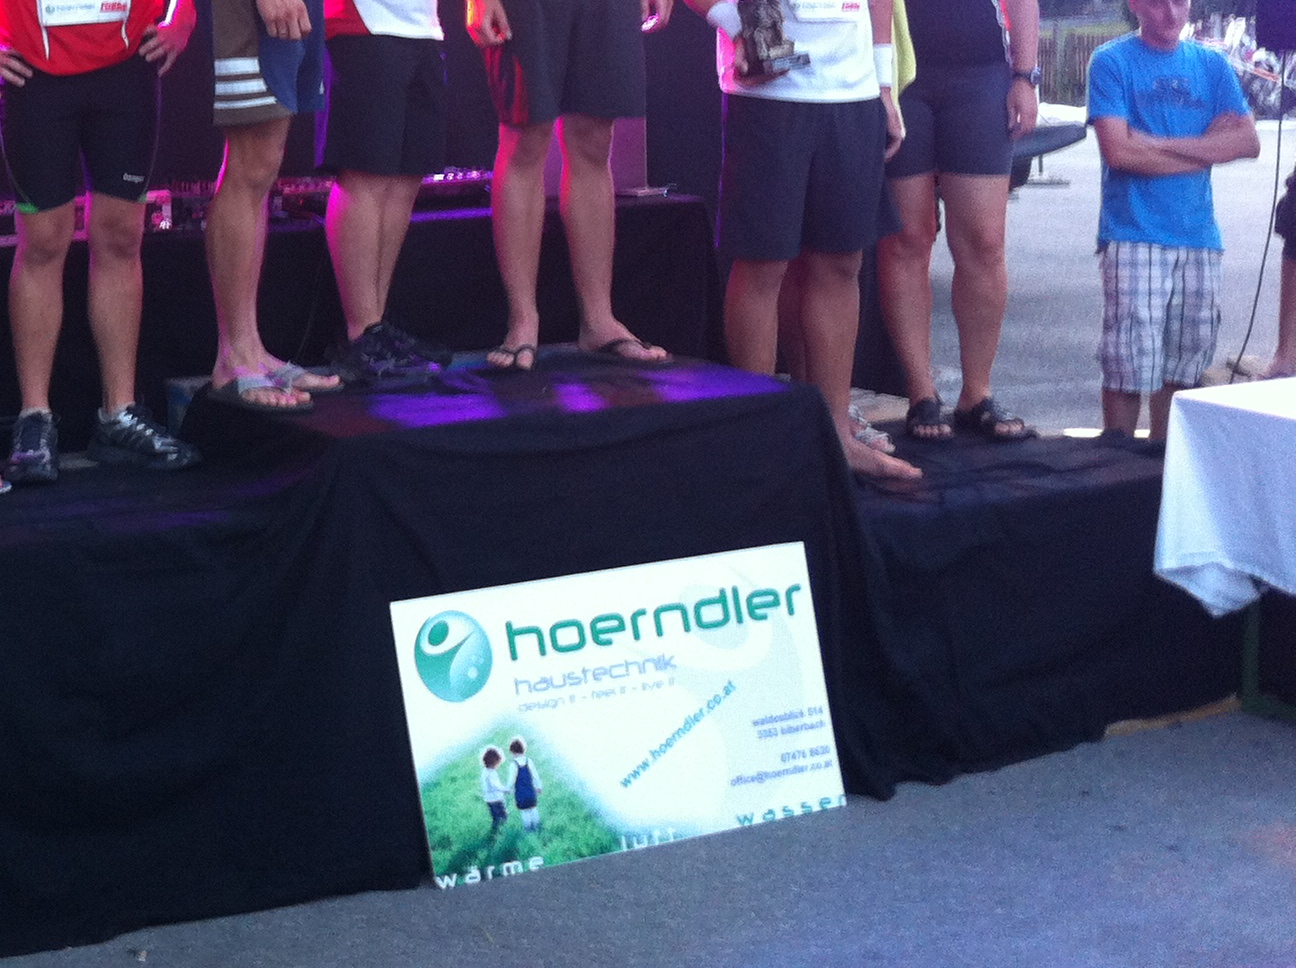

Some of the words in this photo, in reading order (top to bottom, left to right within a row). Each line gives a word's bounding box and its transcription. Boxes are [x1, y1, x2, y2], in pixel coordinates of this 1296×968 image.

[505, 583, 802, 662] hoerndler
[513, 653, 678, 695] haustechnik
[620, 678, 737, 788] www.hoerndler.co.at
[434, 854, 545, 891] wärme
